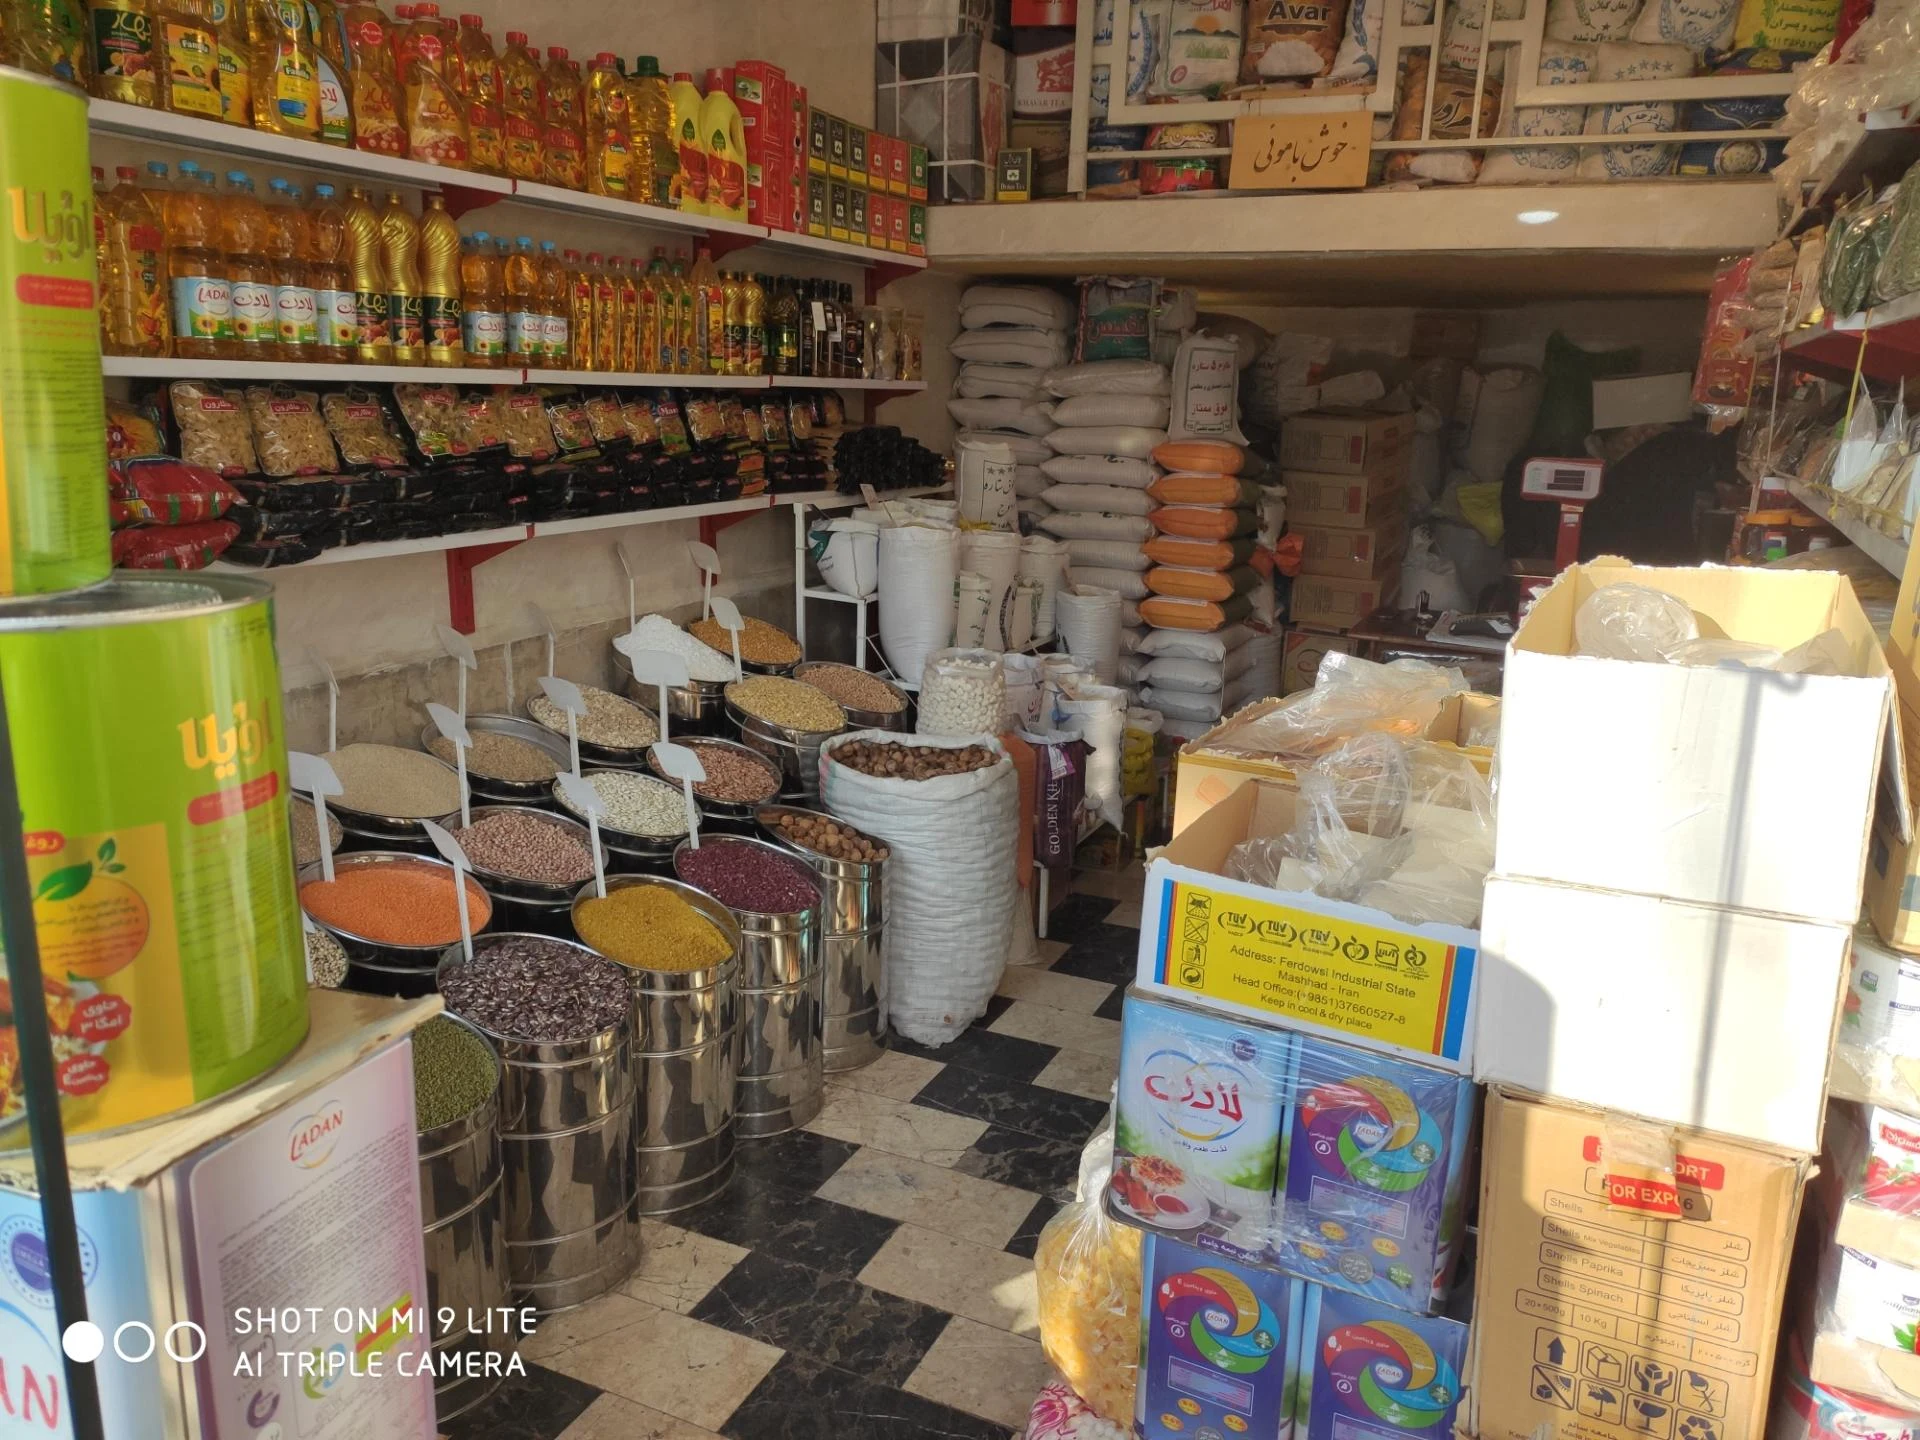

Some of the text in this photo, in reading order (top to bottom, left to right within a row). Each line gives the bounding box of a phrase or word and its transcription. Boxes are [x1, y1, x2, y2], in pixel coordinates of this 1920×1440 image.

[1268, 0, 1333, 21] Avar
[1301, 121, 1348, 172] خوش
[198, 287, 230, 303] LADA
[233, 294, 270, 308] لادن
[279, 296, 313, 311] لادن
[177, 698, 274, 780] اویلا
[1048, 804, 1061, 855] GOLDEN
[1230, 944, 1277, 965] Address:
[1280, 956, 1329, 977] Ferdowsi
[1331, 969, 1382, 990] Industrial
[1385, 982, 1416, 999] State
[1232, 972, 1260, 988] Head
[1278, 969, 1328, 991] Mashhad
[1338, 984, 1360, 998] Iran
[1260, 993, 1373, 1030] Keep in cool & dry place
[290, 1109, 343, 1162] LADAN
[1675, 1161, 1711, 1182] ORT
[1549, 1197, 1584, 1214] Shells
[1683, 1197, 1694, 1210] 6
[1547, 1222, 1580, 1240] Shells
[1545, 1247, 1624, 1278] Shells Paprika
[1543, 1273, 1624, 1304] Shells Spinach
